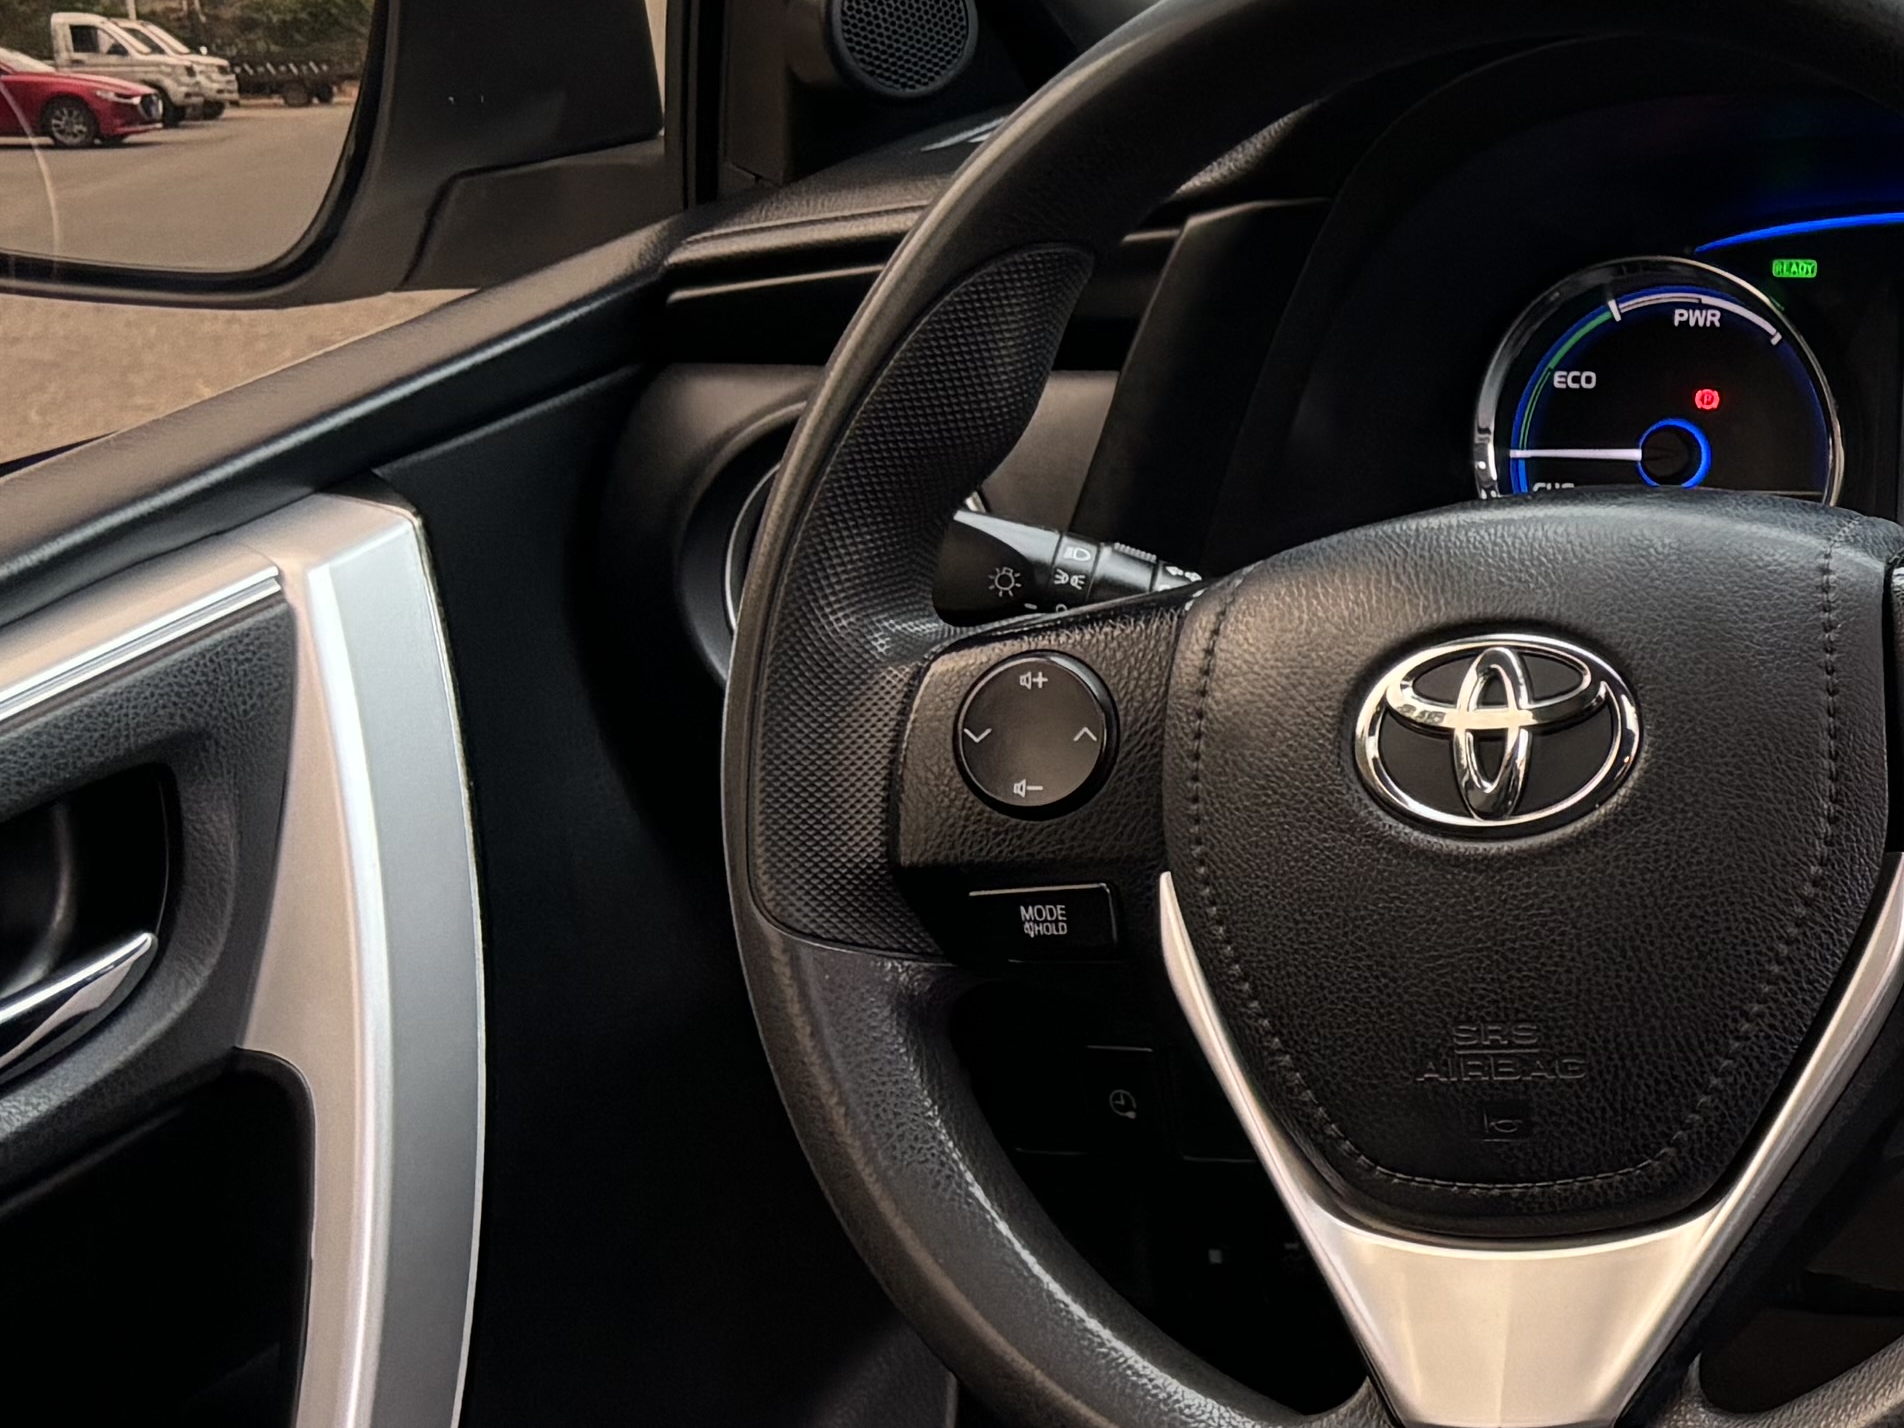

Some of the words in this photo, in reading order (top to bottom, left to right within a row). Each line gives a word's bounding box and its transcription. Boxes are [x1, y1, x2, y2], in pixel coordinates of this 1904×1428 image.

[1673, 309, 1721, 327] PWR
[1553, 370, 1597, 390] ECO
[1019, 904, 1068, 922] MODE
[1034, 922, 1069, 936] HOLD
[1452, 1022, 1538, 1045] SRS
[1415, 1056, 1587, 1082] AIRBAG
